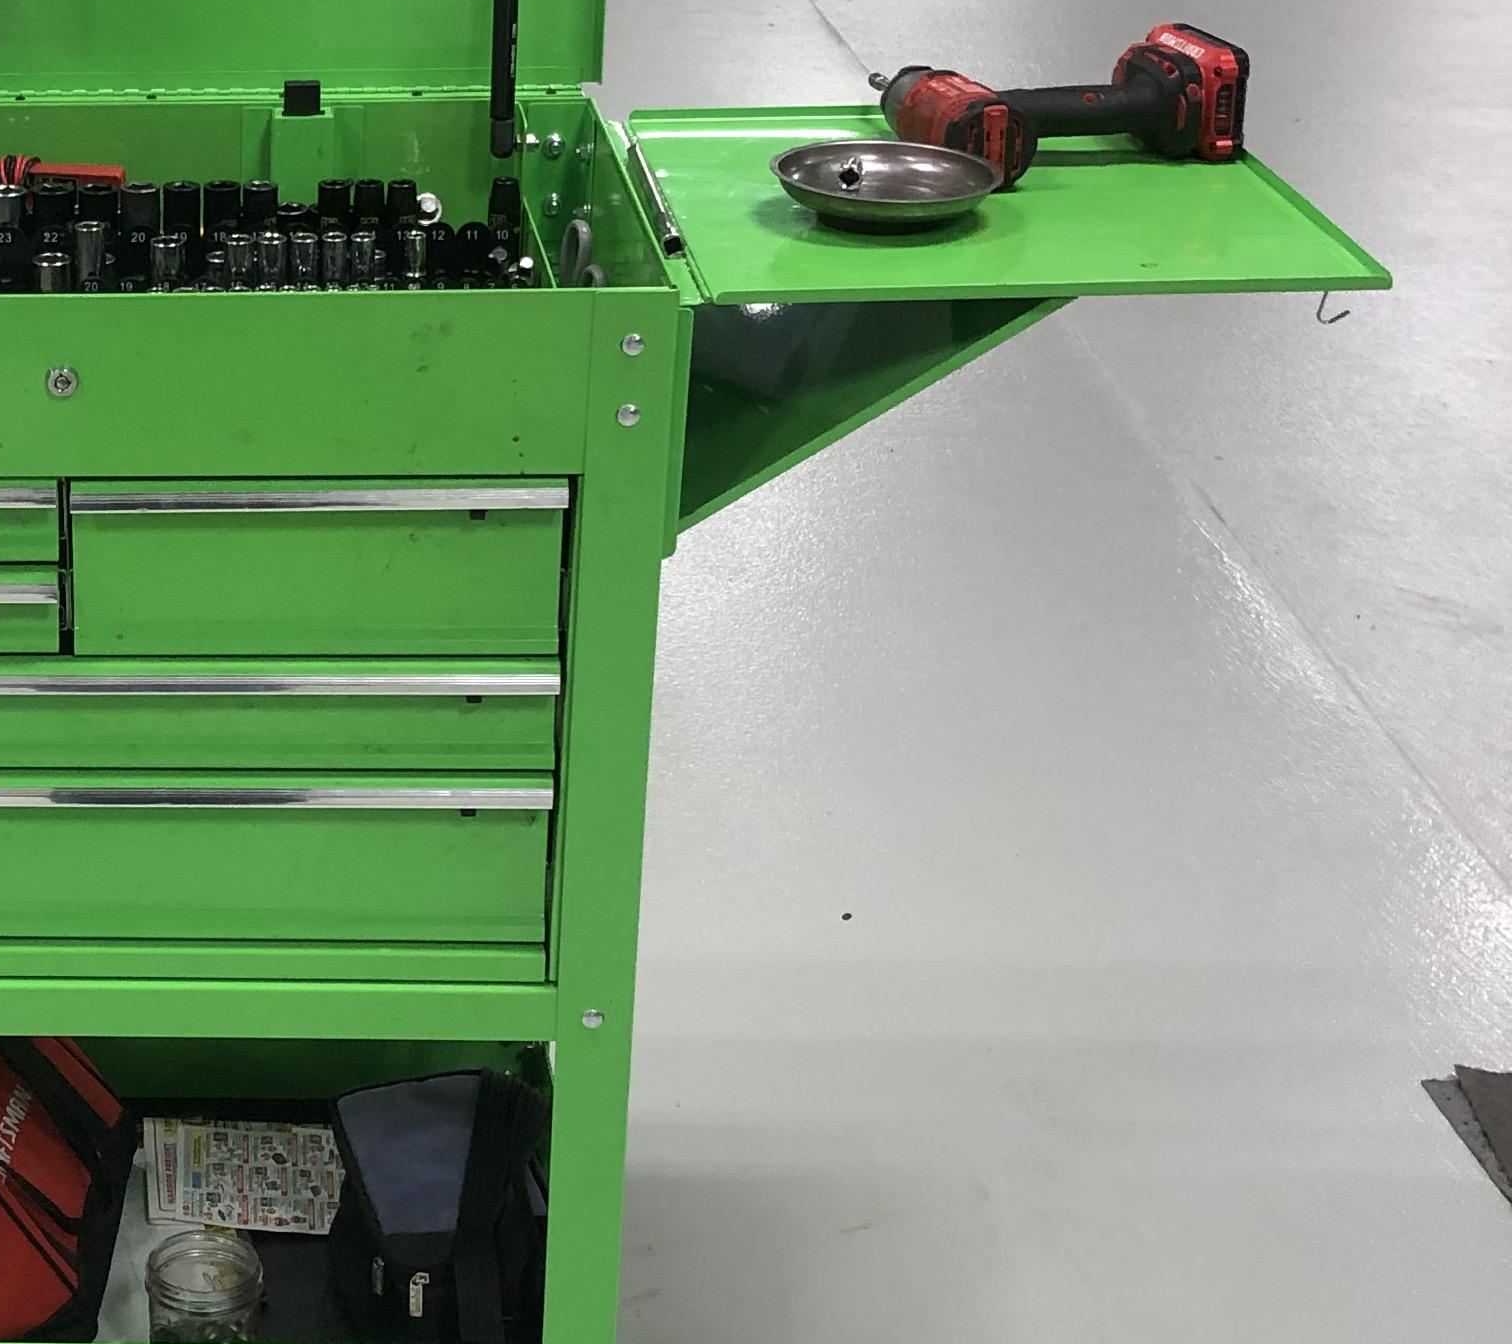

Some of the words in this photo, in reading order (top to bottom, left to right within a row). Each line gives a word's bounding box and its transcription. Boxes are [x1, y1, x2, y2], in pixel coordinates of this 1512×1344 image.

[43, 232, 58, 243] 22
[130, 233, 146, 243] 20
[214, 232, 227, 242] 18
[431, 230, 445, 241] 12
[466, 230, 479, 240] 11
[496, 230, 509, 241] 10
[84, 281, 99, 292] 20
[120, 281, 134, 292] 19
[436, 281, 445, 290] 9
